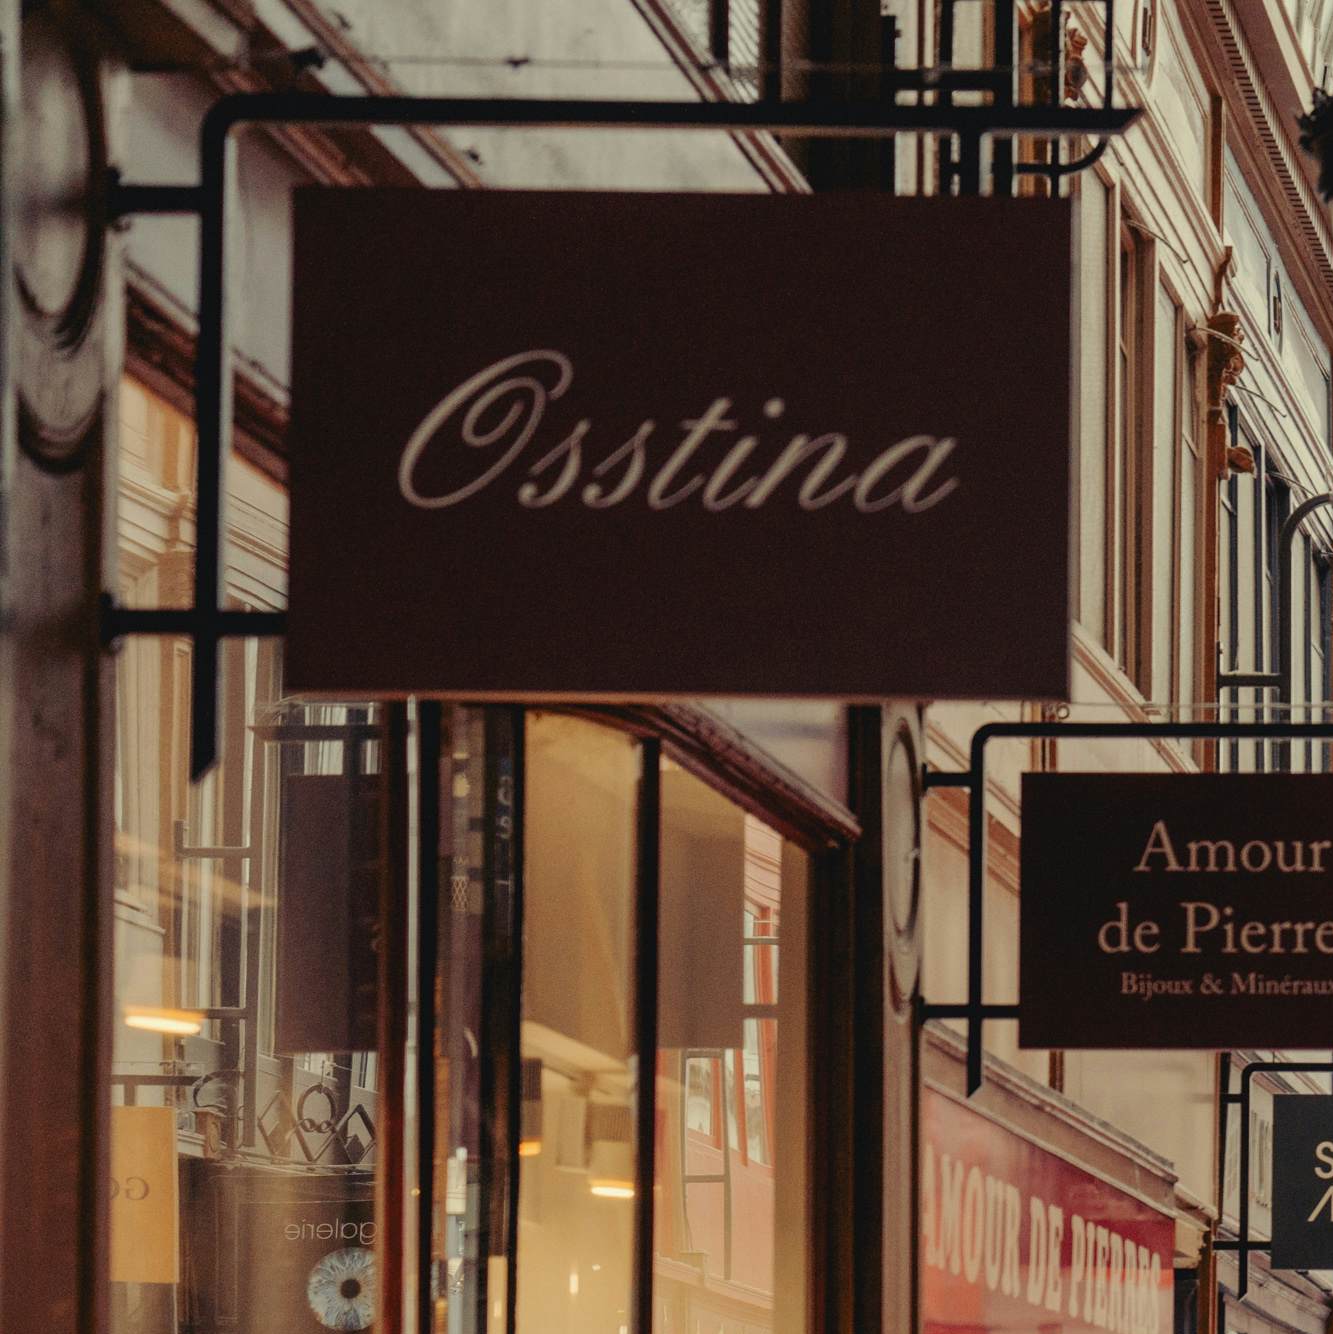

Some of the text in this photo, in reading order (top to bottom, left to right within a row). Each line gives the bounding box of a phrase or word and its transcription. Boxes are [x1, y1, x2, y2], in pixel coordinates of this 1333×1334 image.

[399, 349, 961, 514] Osstina
[1133, 820, 1332, 872] Amour
[1098, 902, 1161, 953] de
[1120, 971, 1193, 1000] Bijoux
[1200, 971, 1223, 995] &
[1027, 1196, 1064, 1313] DE
